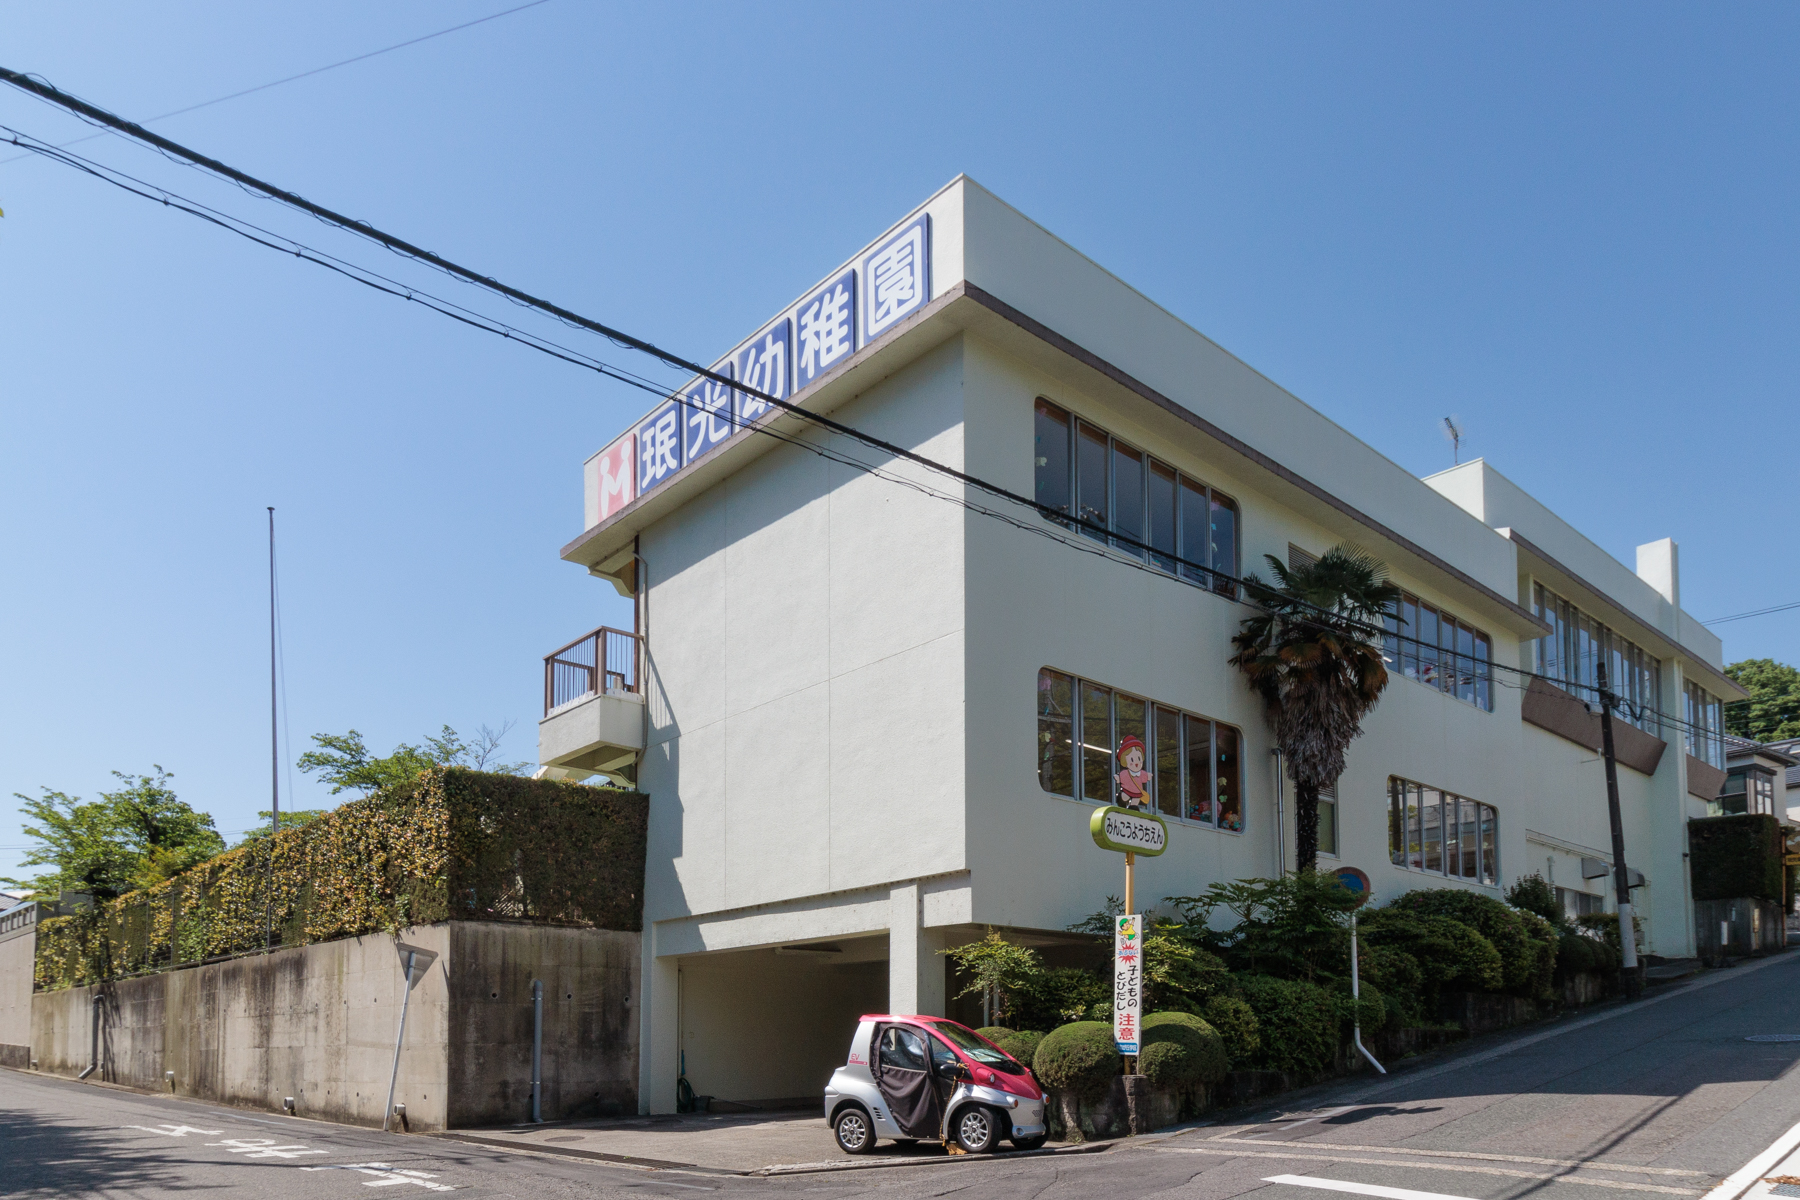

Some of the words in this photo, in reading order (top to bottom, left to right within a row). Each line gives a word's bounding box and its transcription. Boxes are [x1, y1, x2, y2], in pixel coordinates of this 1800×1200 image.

[641, 225, 922, 489] 珉光幼稚園
[1106, 817, 1164, 845] みんこうようちえん
[1116, 971, 1127, 1011] とびだし
[1127, 965, 1138, 1008] 子どもの
[1118, 1013, 1135, 1041] 注意
